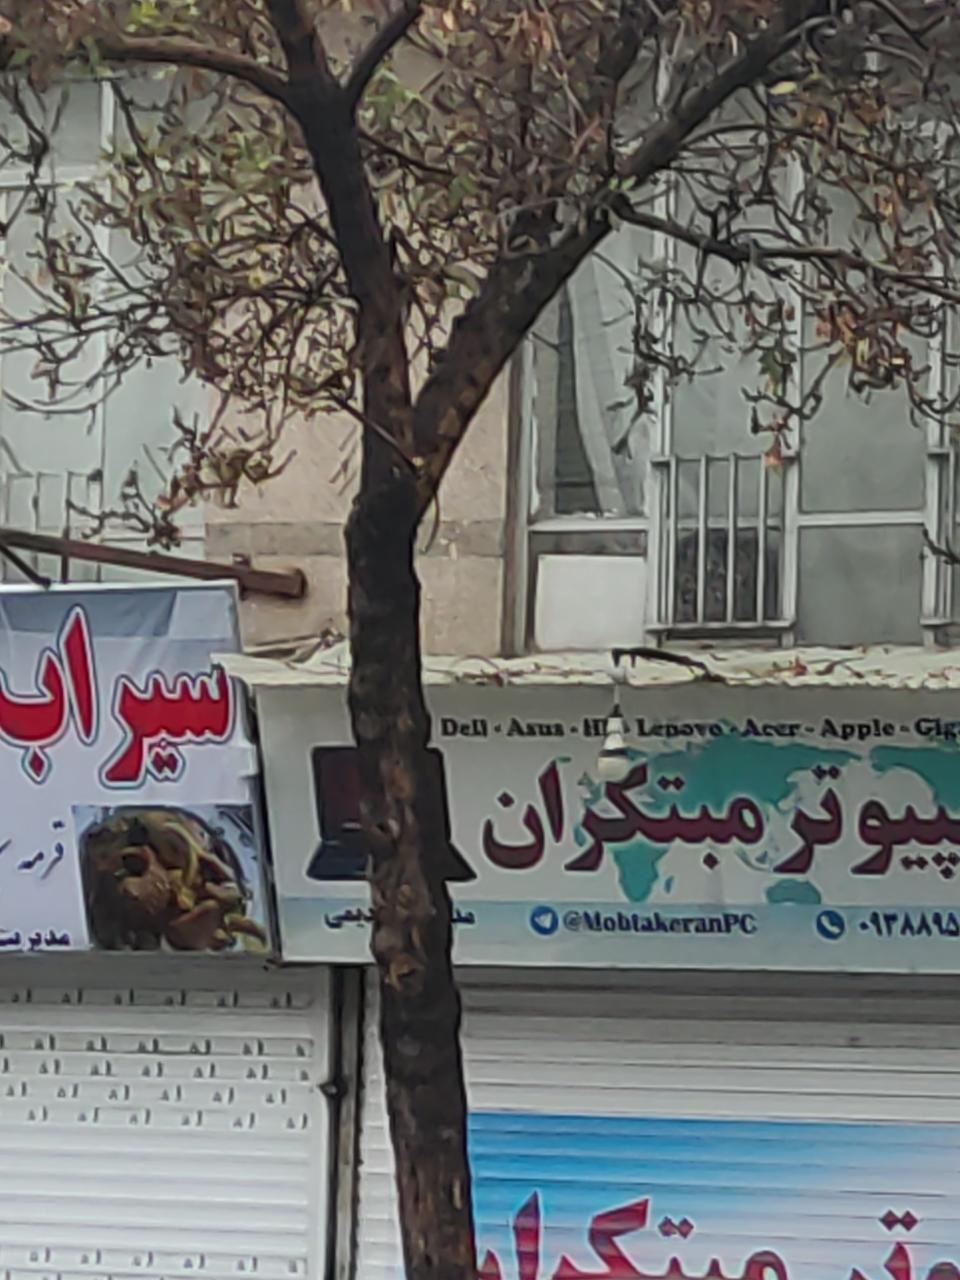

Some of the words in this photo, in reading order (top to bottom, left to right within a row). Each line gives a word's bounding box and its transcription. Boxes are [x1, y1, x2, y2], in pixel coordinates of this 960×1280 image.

[440, 718, 488, 737] Dell
[507, 718, 564, 737] Asus
[744, 717, 799, 737] Acer
[820, 718, 895, 741] Apple
[482, 760, 764, 872] مبتکران
